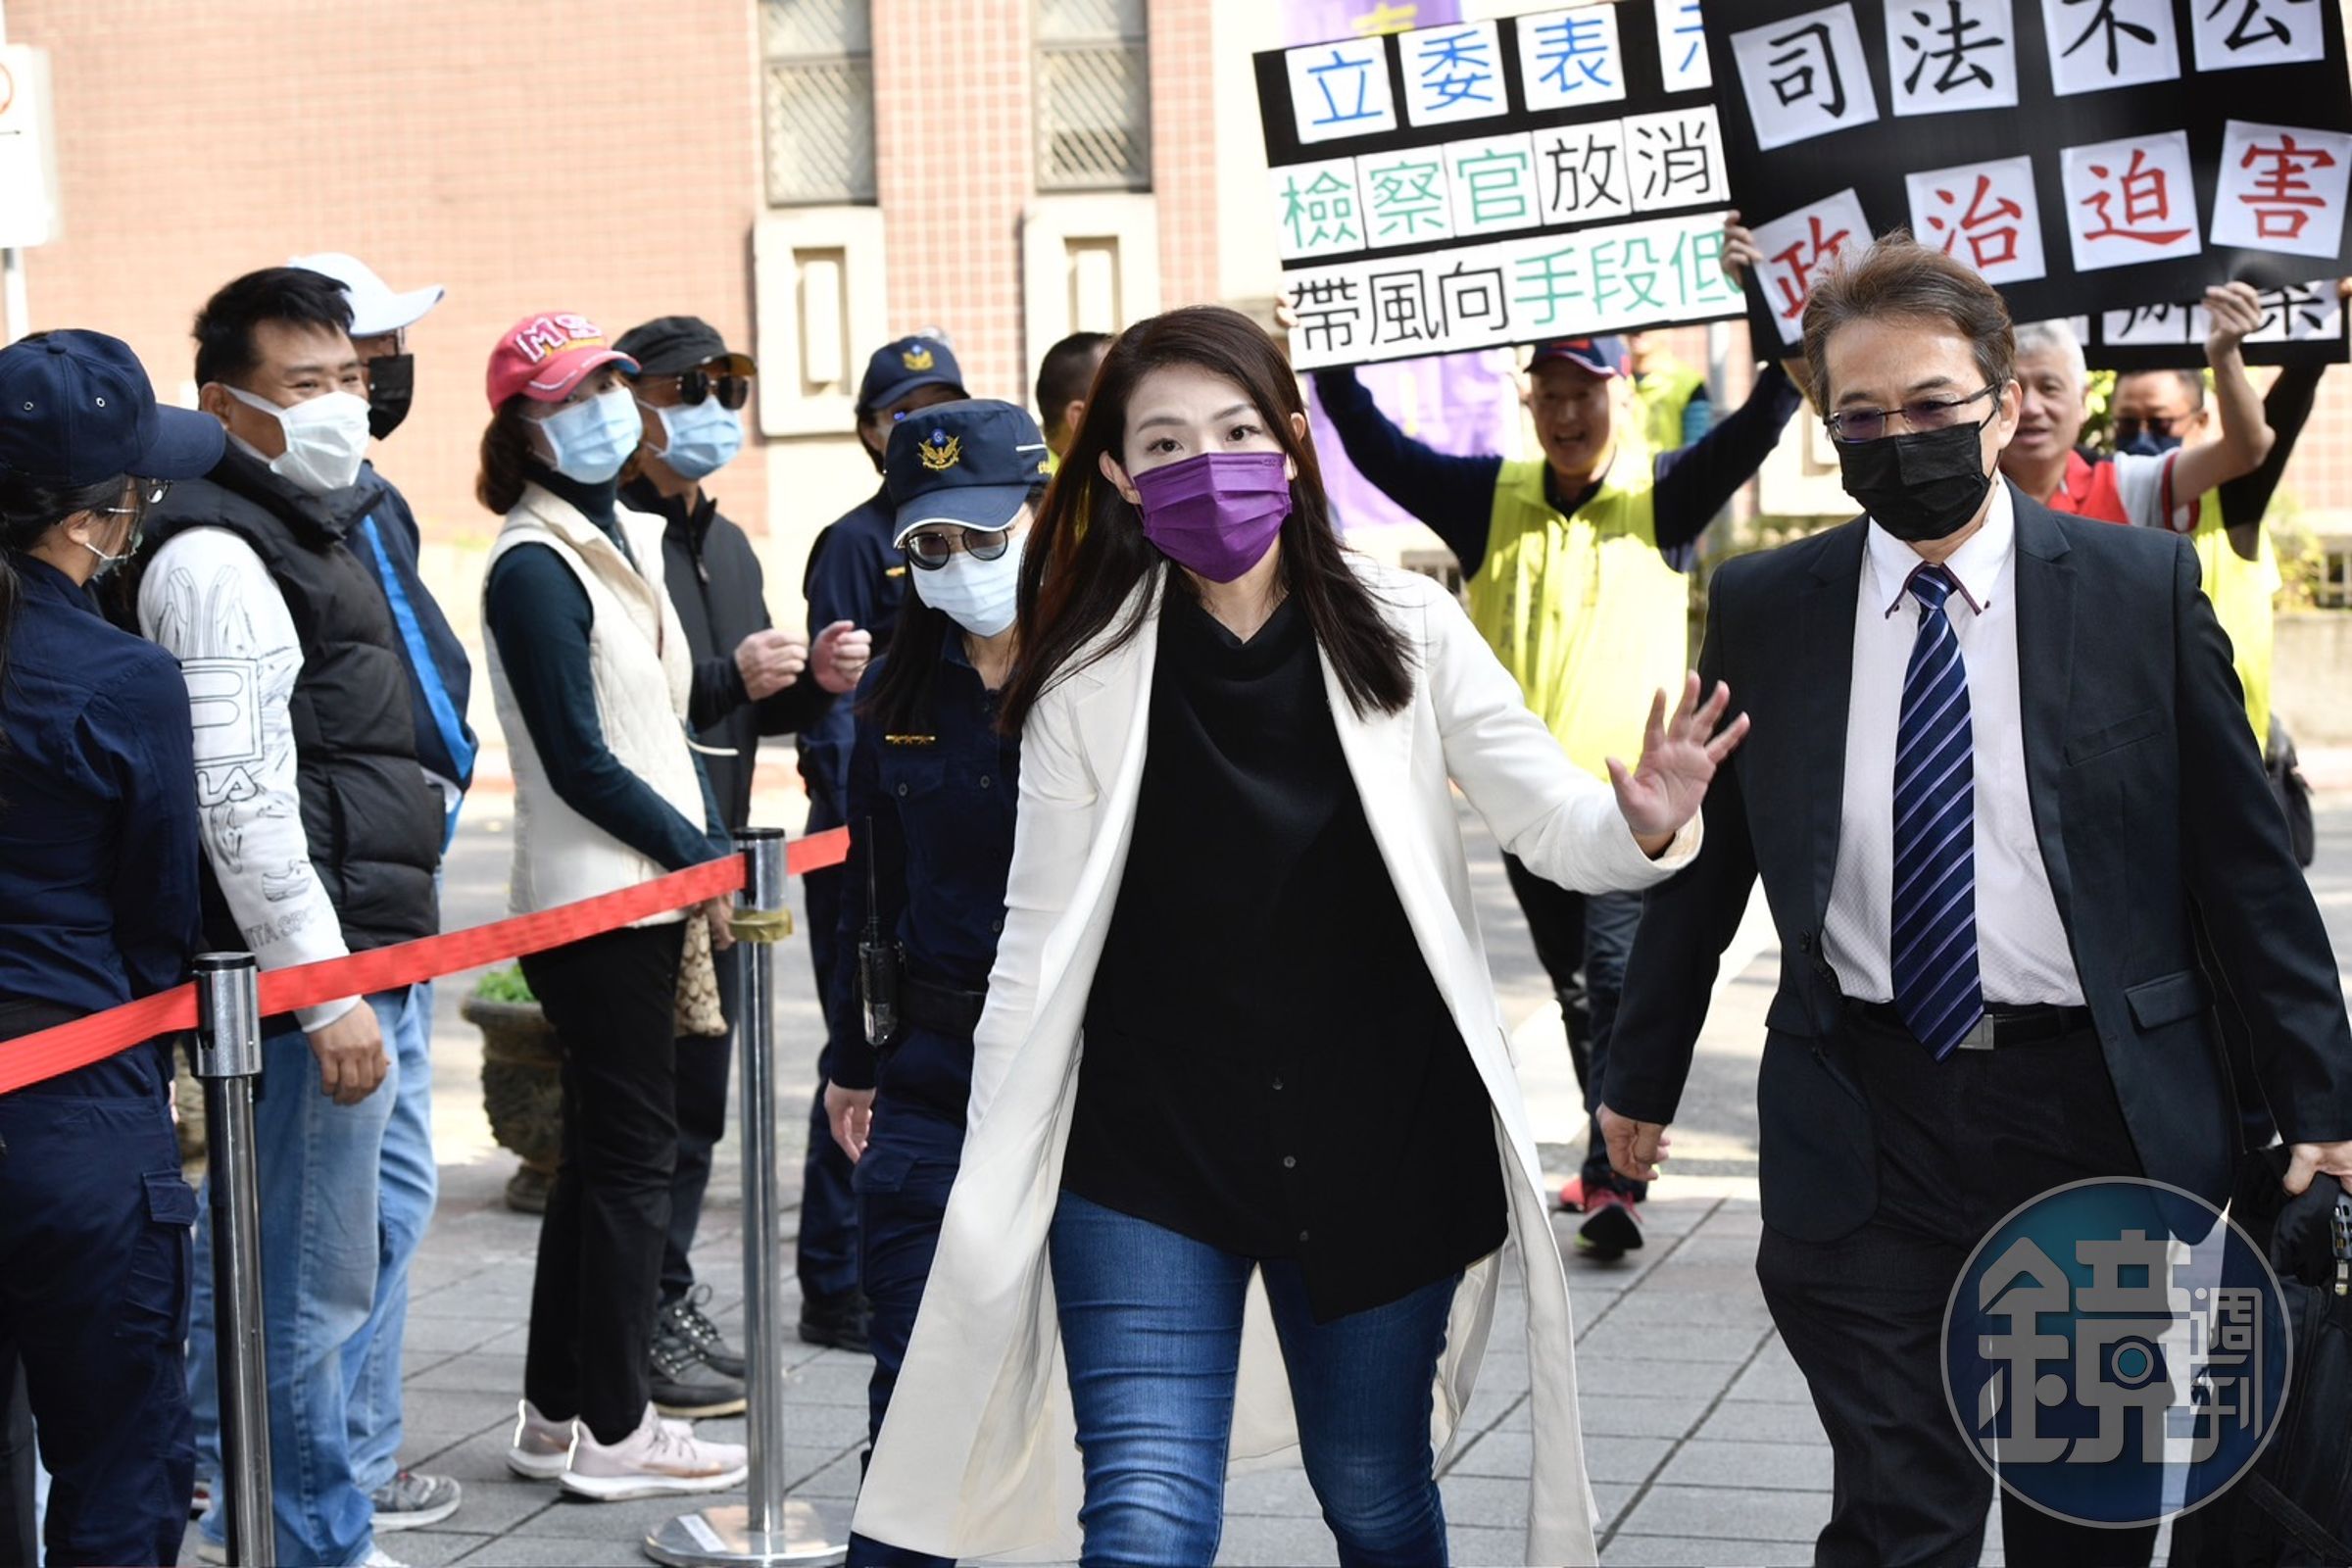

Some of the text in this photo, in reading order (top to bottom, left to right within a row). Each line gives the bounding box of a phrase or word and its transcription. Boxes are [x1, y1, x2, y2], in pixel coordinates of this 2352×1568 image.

[1280, 121, 1710, 249] 檢察官放消
[1770, 133, 2336, 318] 政治迫害
[1289, 228, 1743, 353] 帶風向手段低
